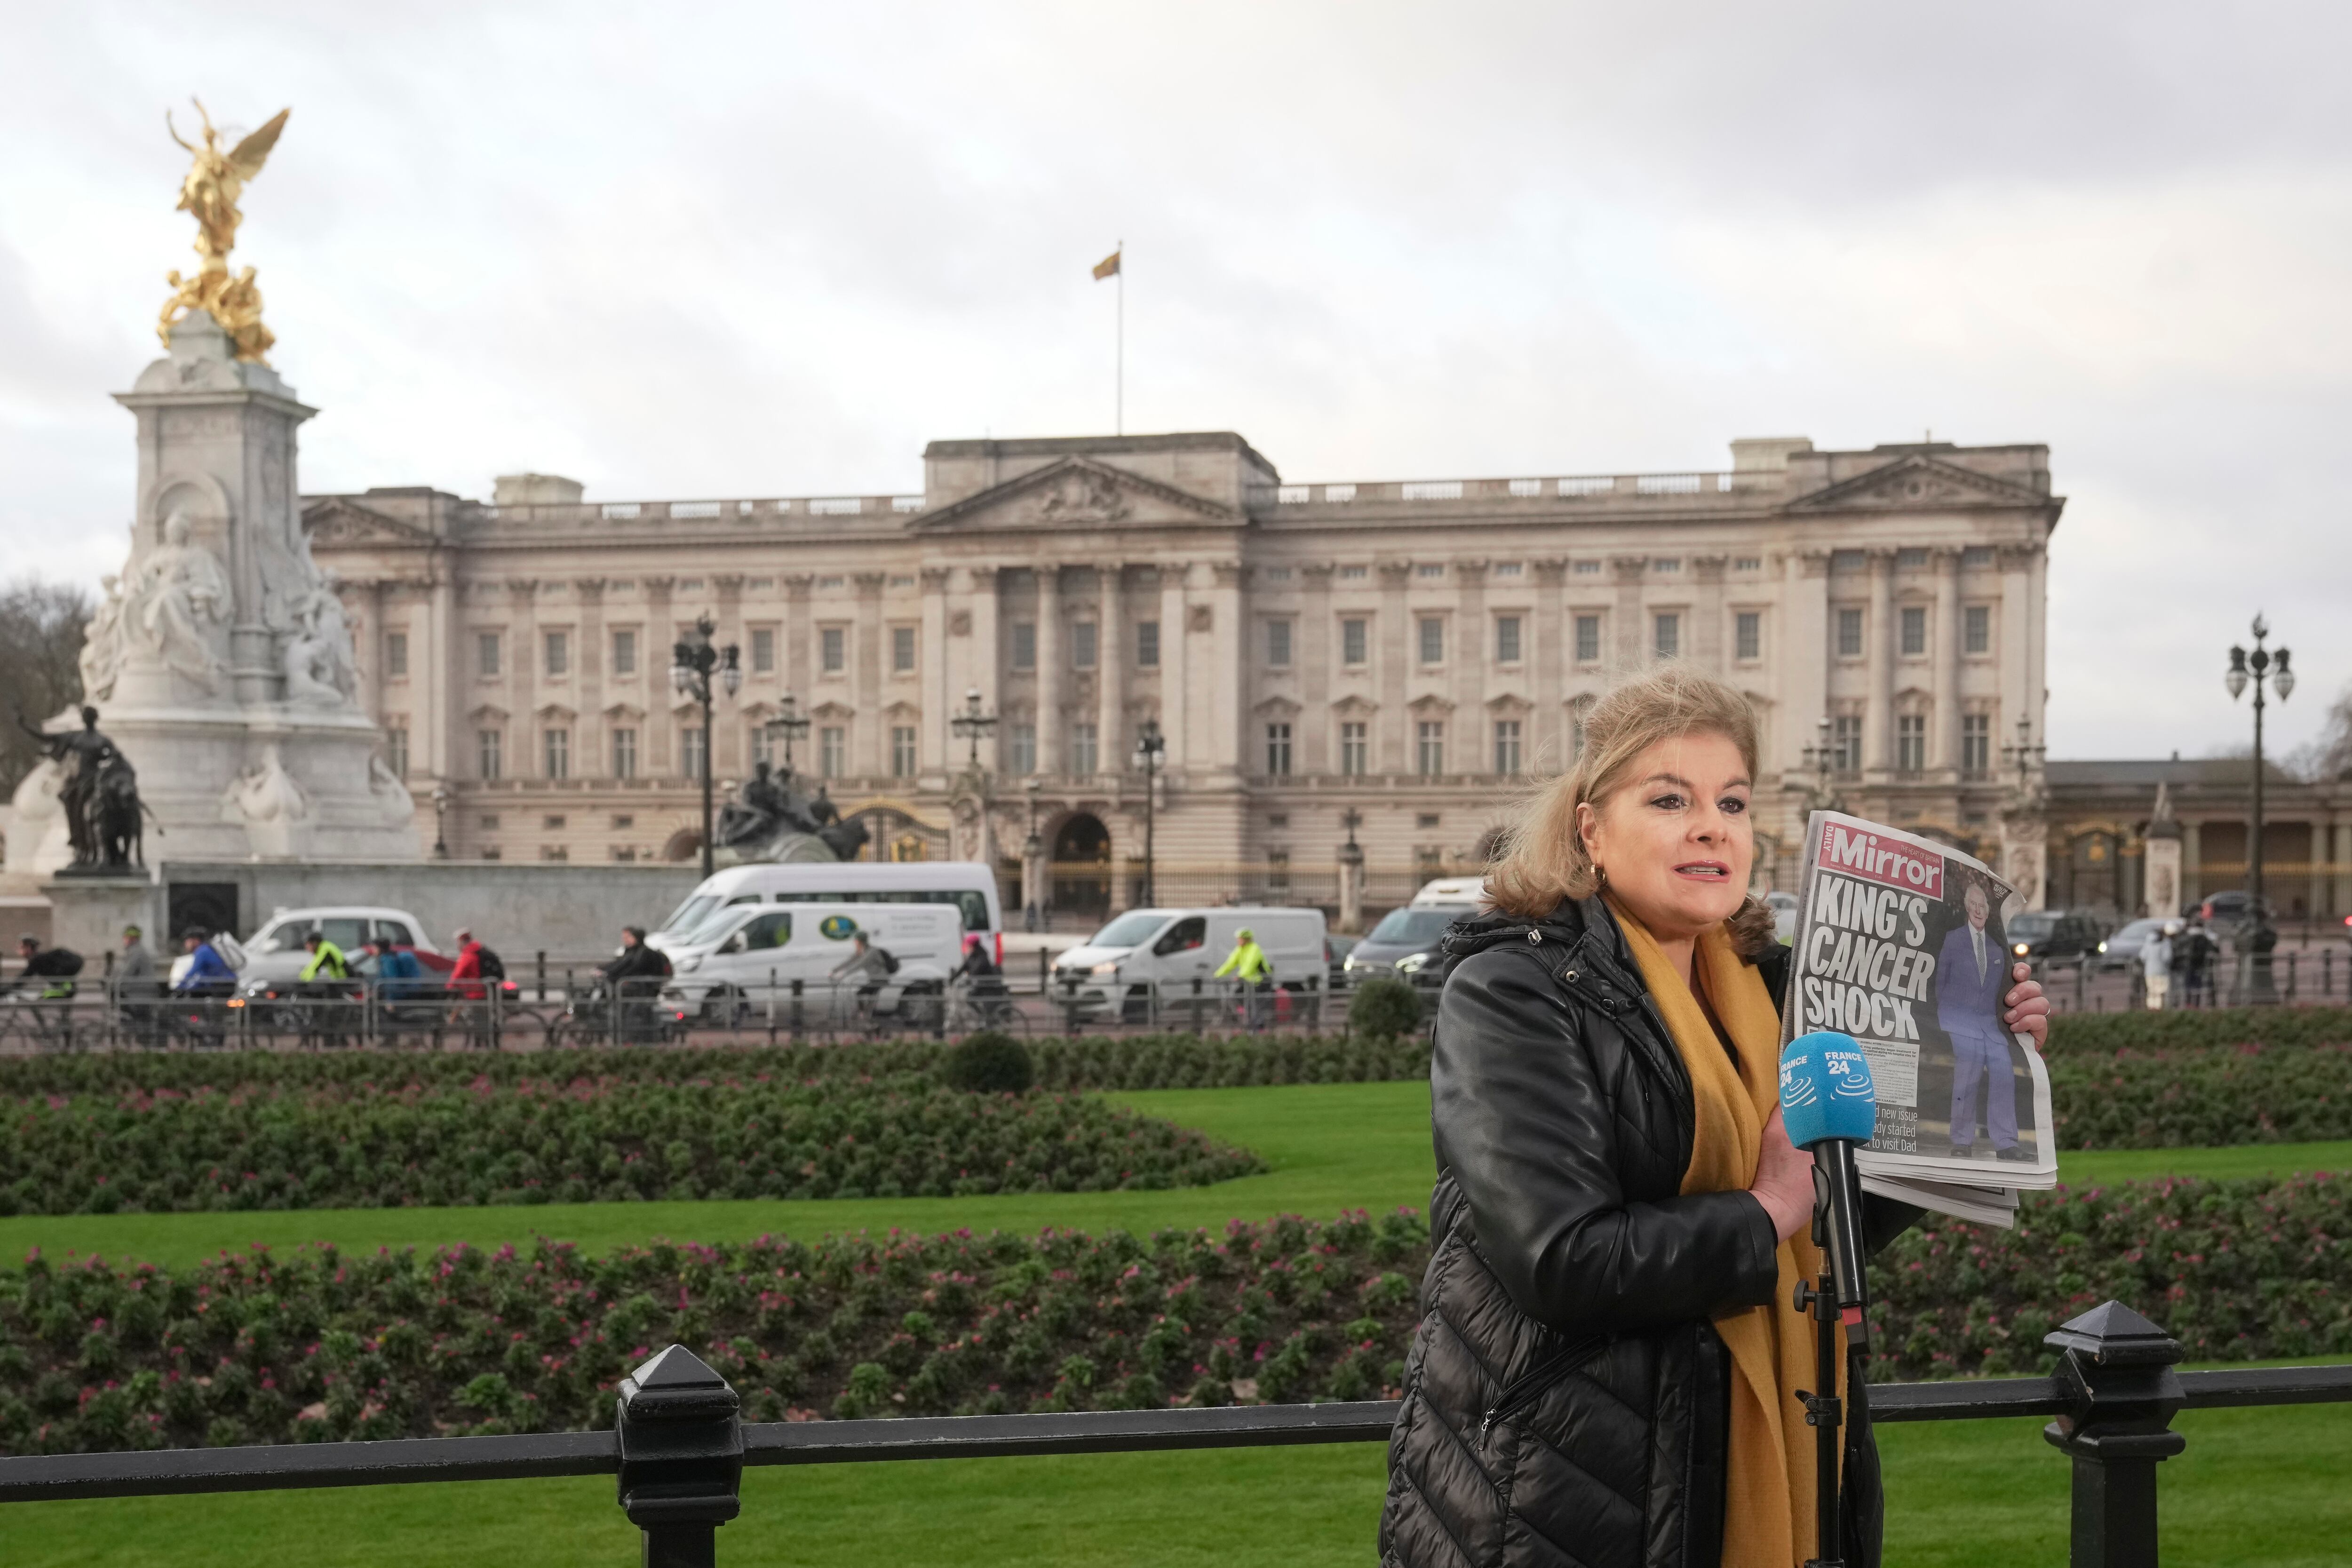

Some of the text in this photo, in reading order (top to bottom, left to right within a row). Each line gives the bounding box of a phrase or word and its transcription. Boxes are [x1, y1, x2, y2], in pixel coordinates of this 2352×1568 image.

[1823, 826, 1834, 852] DAILY
[1830, 828, 1940, 889] Mirror
[1908, 848, 1920, 858] HEART
[1925, 854, 1939, 864] BRITAIN
[1994, 883, 2008, 893] HEALTH
[1815, 874, 1928, 947] KING'S
[1809, 926, 1936, 1003] CANCER
[1804, 977, 1920, 1041] SHOCK
[1780, 1055, 1807, 1074] FRANCE
[1825, 1052, 1863, 1062] FRANCE
[1828, 1060, 1851, 1075] 24
[1780, 1070, 1792, 1089] 24
[1882, 1108, 1896, 1119] new
[1899, 1107, 1918, 1122] issue
[1887, 1122, 1916, 1137] started
[1872, 1136, 1880, 1148] to
[1882, 1138, 1899, 1150] visit
[1901, 1139, 1916, 1152] Dad
